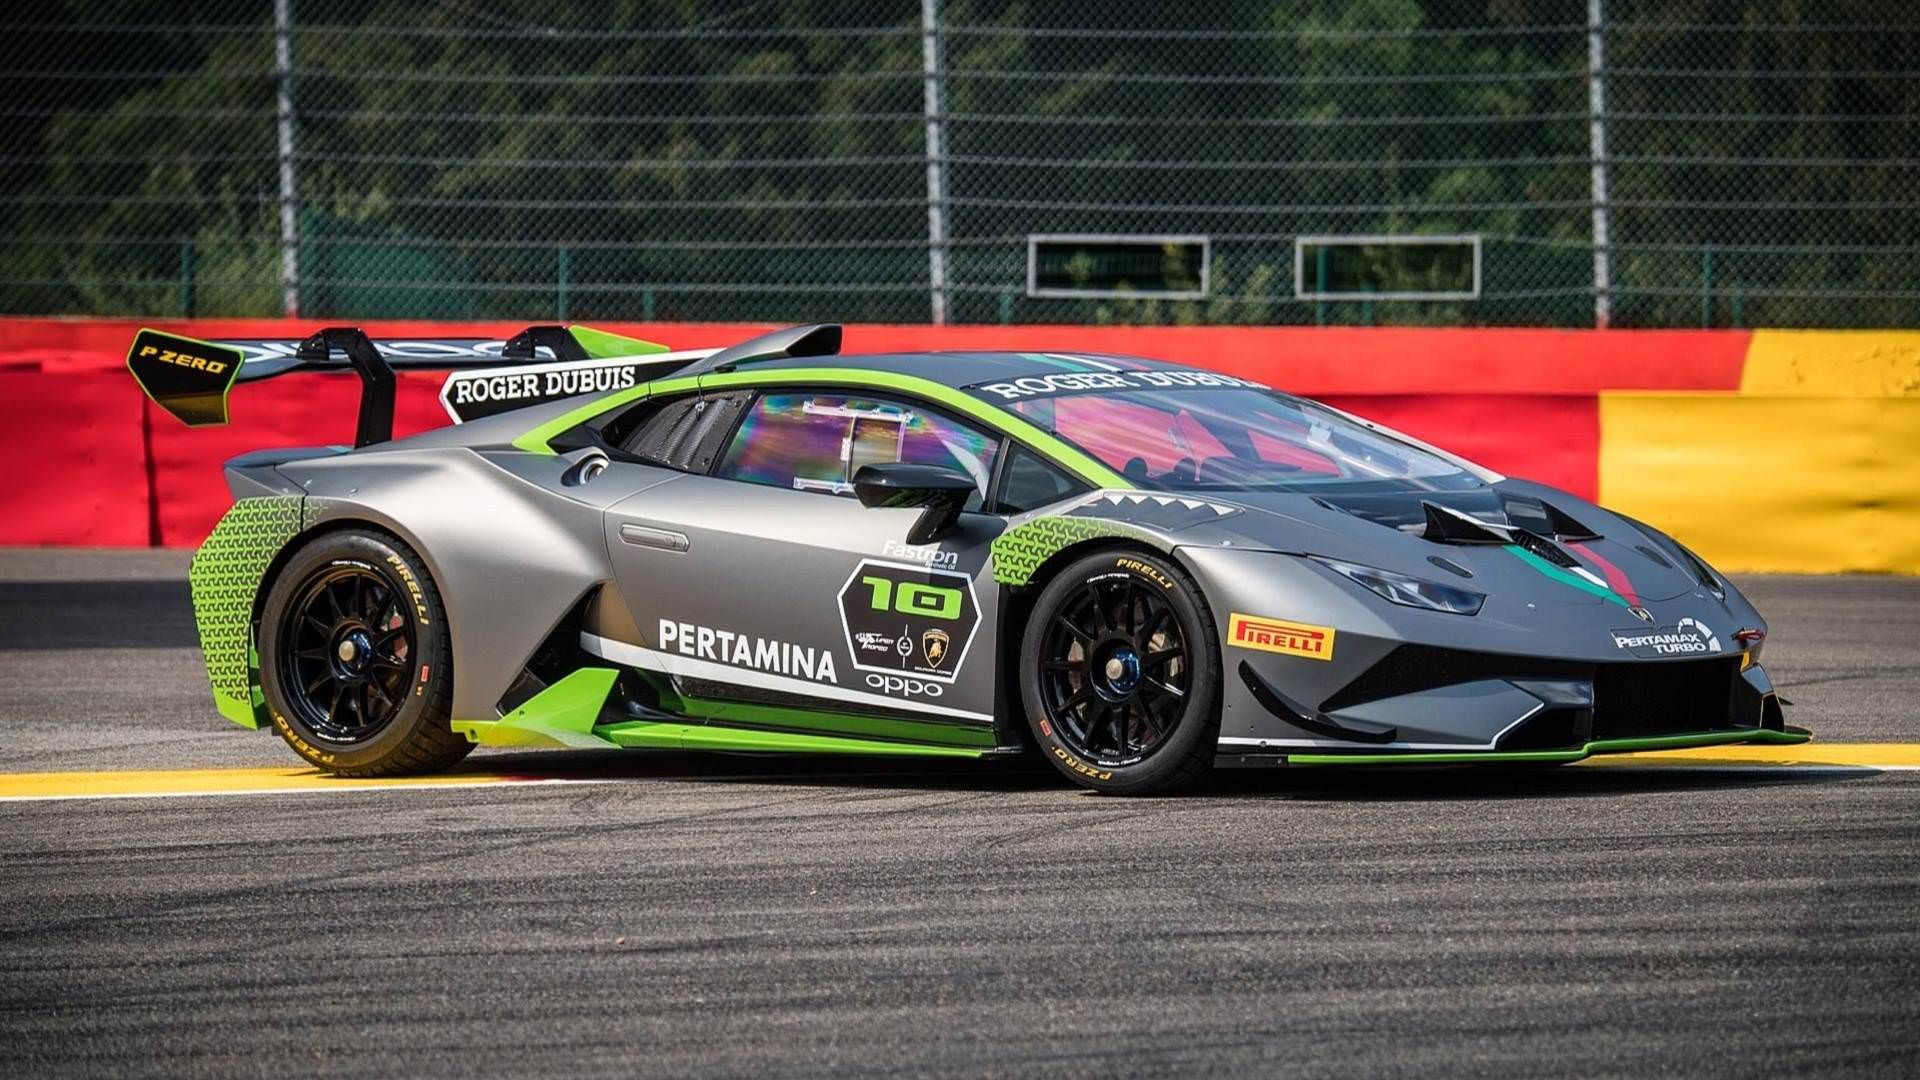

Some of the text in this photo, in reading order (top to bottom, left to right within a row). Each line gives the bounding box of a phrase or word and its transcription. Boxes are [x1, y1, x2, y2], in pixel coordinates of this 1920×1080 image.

[139, 345, 158, 357] P
[159, 350, 226, 374] ZERO
[456, 366, 635, 403] ROGER DUBUIS
[981, 373, 1140, 399] ROGER
[882, 540, 958, 564] Fastron
[1116, 558, 1173, 589] PIRELLI
[387, 555, 429, 625] PIRELLI
[862, 576, 963, 620] 10
[659, 618, 838, 684] PERTAMINA
[1236, 620, 1324, 653] PIRELLI
[1614, 633, 1701, 648] PERTAMAX
[1653, 642, 1707, 654] TURBO
[865, 673, 944, 697] oppo
